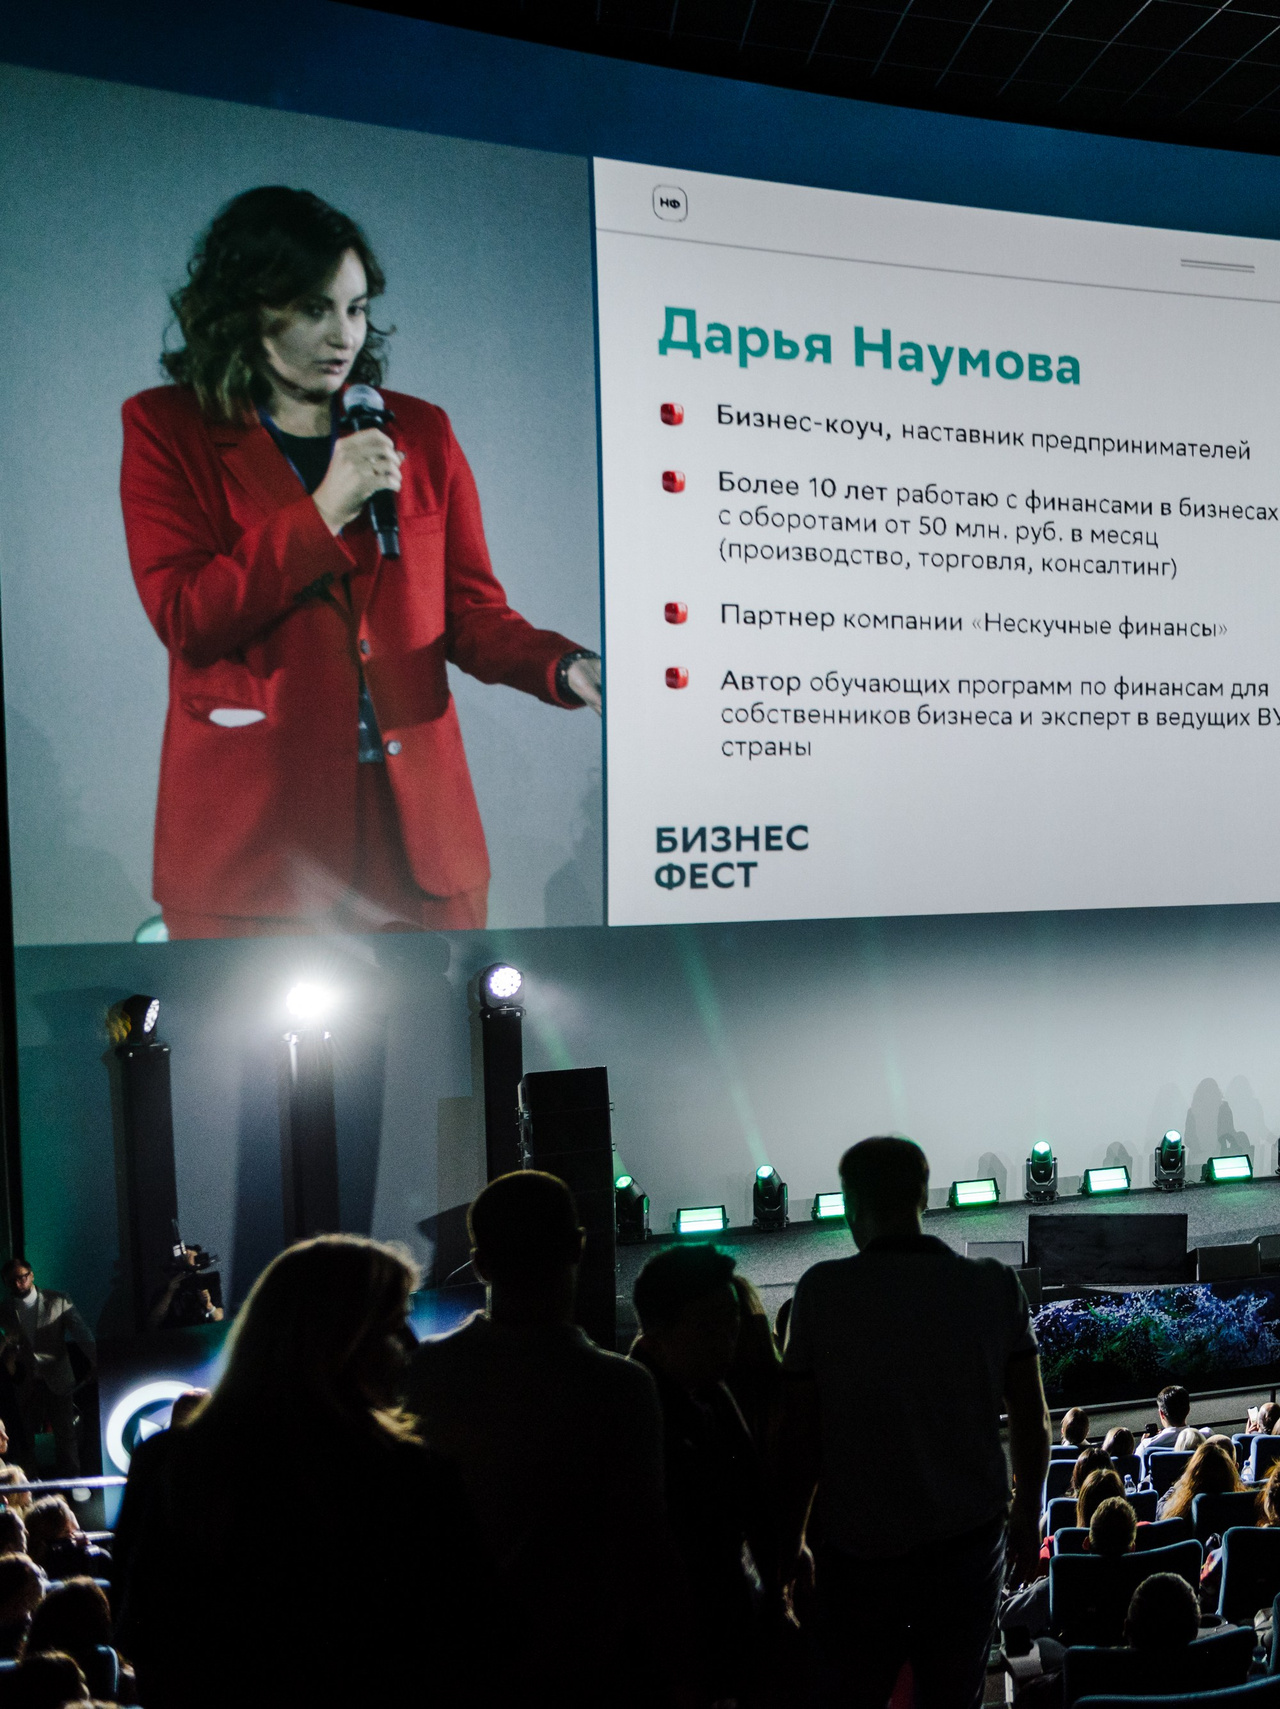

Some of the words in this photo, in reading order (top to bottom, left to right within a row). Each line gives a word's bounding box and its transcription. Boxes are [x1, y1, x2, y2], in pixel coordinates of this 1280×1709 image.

[658, 306, 831, 368] Дарья
[854, 326, 1080, 386] Наумова
[718, 404, 891, 441] Бизнес-коуч,
[903, 424, 1024, 446] наставник
[1032, 433, 1250, 460] предпринимателей
[719, 471, 799, 496] Более
[810, 477, 836, 498] 10
[844, 485, 887, 501] лет
[897, 483, 998, 507] работаю
[1006, 493, 1017, 509] с
[1025, 490, 1152, 515] финансами
[1161, 502, 1171, 516] в
[1179, 497, 1278, 520] бизнесах
[718, 509, 730, 525] с
[739, 505, 876, 533] оборотами
[885, 519, 910, 534] от
[920, 516, 947, 536] 50
[956, 523, 1007, 539] млн.
[1016, 521, 1062, 545] руб.
[1071, 528, 1082, 542] в
[1091, 529, 1158, 548] месяц
[719, 538, 911, 571] (производство,
[919, 552, 1032, 574] торговля,
[1042, 558, 1177, 579] консалтинг)
[721, 603, 835, 631] Партнер
[844, 613, 962, 630] компании
[971, 612, 1112, 637] «Нескучные
[1118, 615, 1229, 640] финансы»
[721, 670, 801, 696] Автор
[810, 671, 950, 696] обучающих
[958, 679, 1071, 698] программ
[1081, 681, 1106, 695] по
[1114, 676, 1223, 700] финансам
[1231, 683, 1268, 699] для
[721, 702, 910, 724] собственников
[917, 704, 1012, 726] бизнеса
[1020, 712, 1032, 725] и
[1042, 711, 1130, 729] эксперт
[1138, 712, 1148, 726] в
[1157, 712, 1250, 730] ведущих
[722, 741, 811, 760] страны
[656, 825, 808, 853] БИЗНЕС
[655, 861, 758, 890] ФЕСТ
